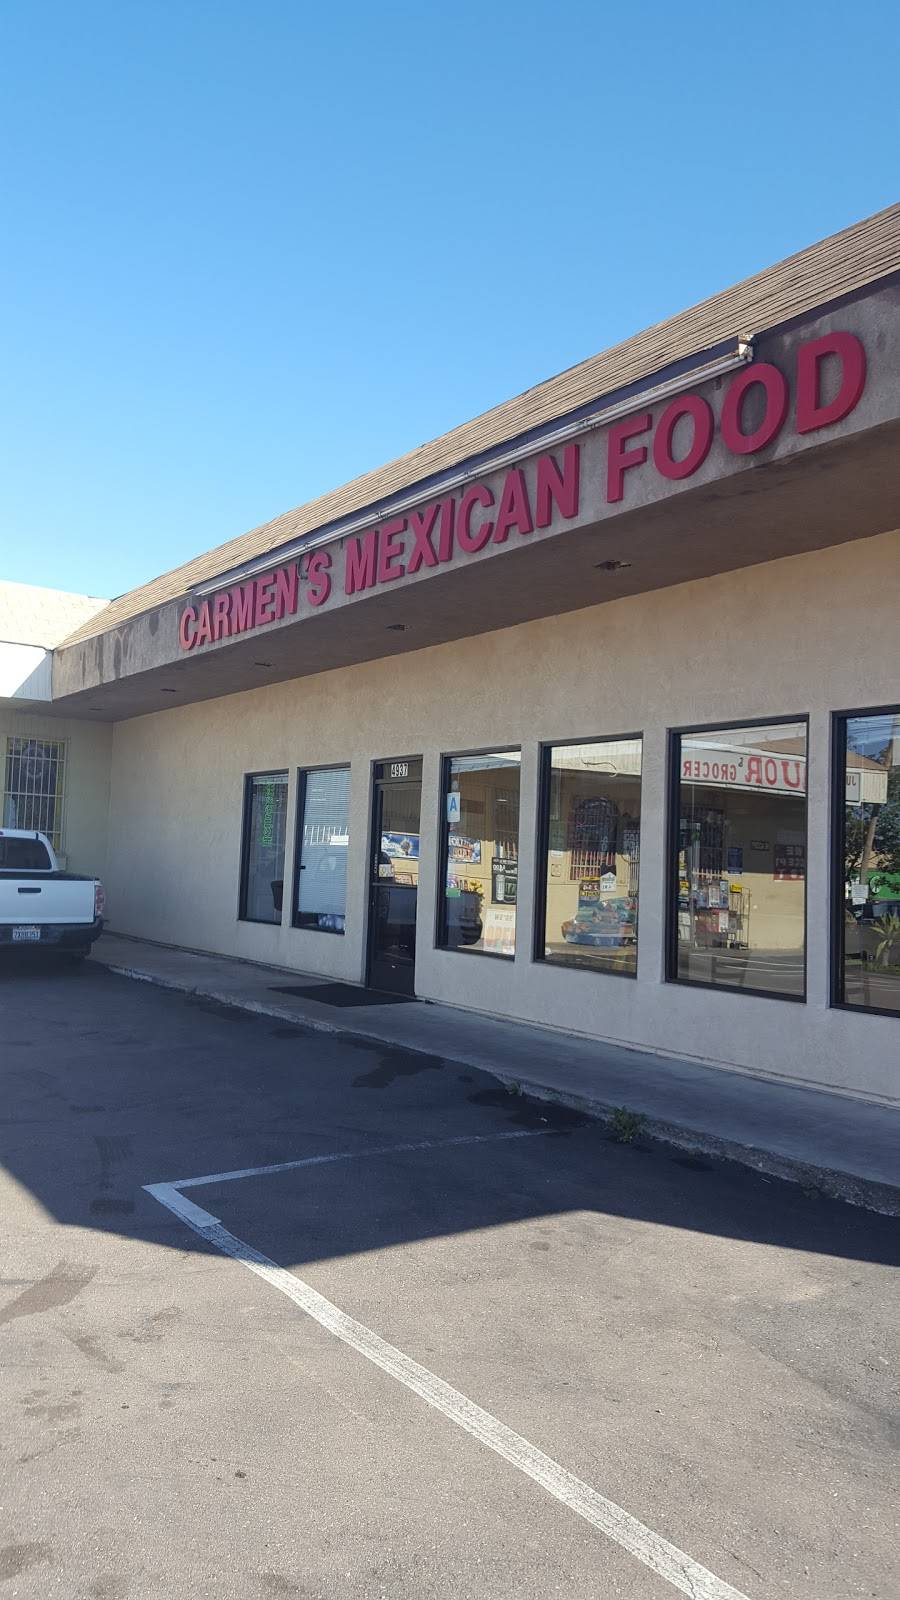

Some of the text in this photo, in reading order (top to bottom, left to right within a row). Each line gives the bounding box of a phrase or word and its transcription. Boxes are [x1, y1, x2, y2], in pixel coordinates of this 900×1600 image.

[180, 331, 868, 650] CARMEN'S MEXICAN FOOD
[392, 763, 408, 777] 4937
[449, 797, 457, 811] A
